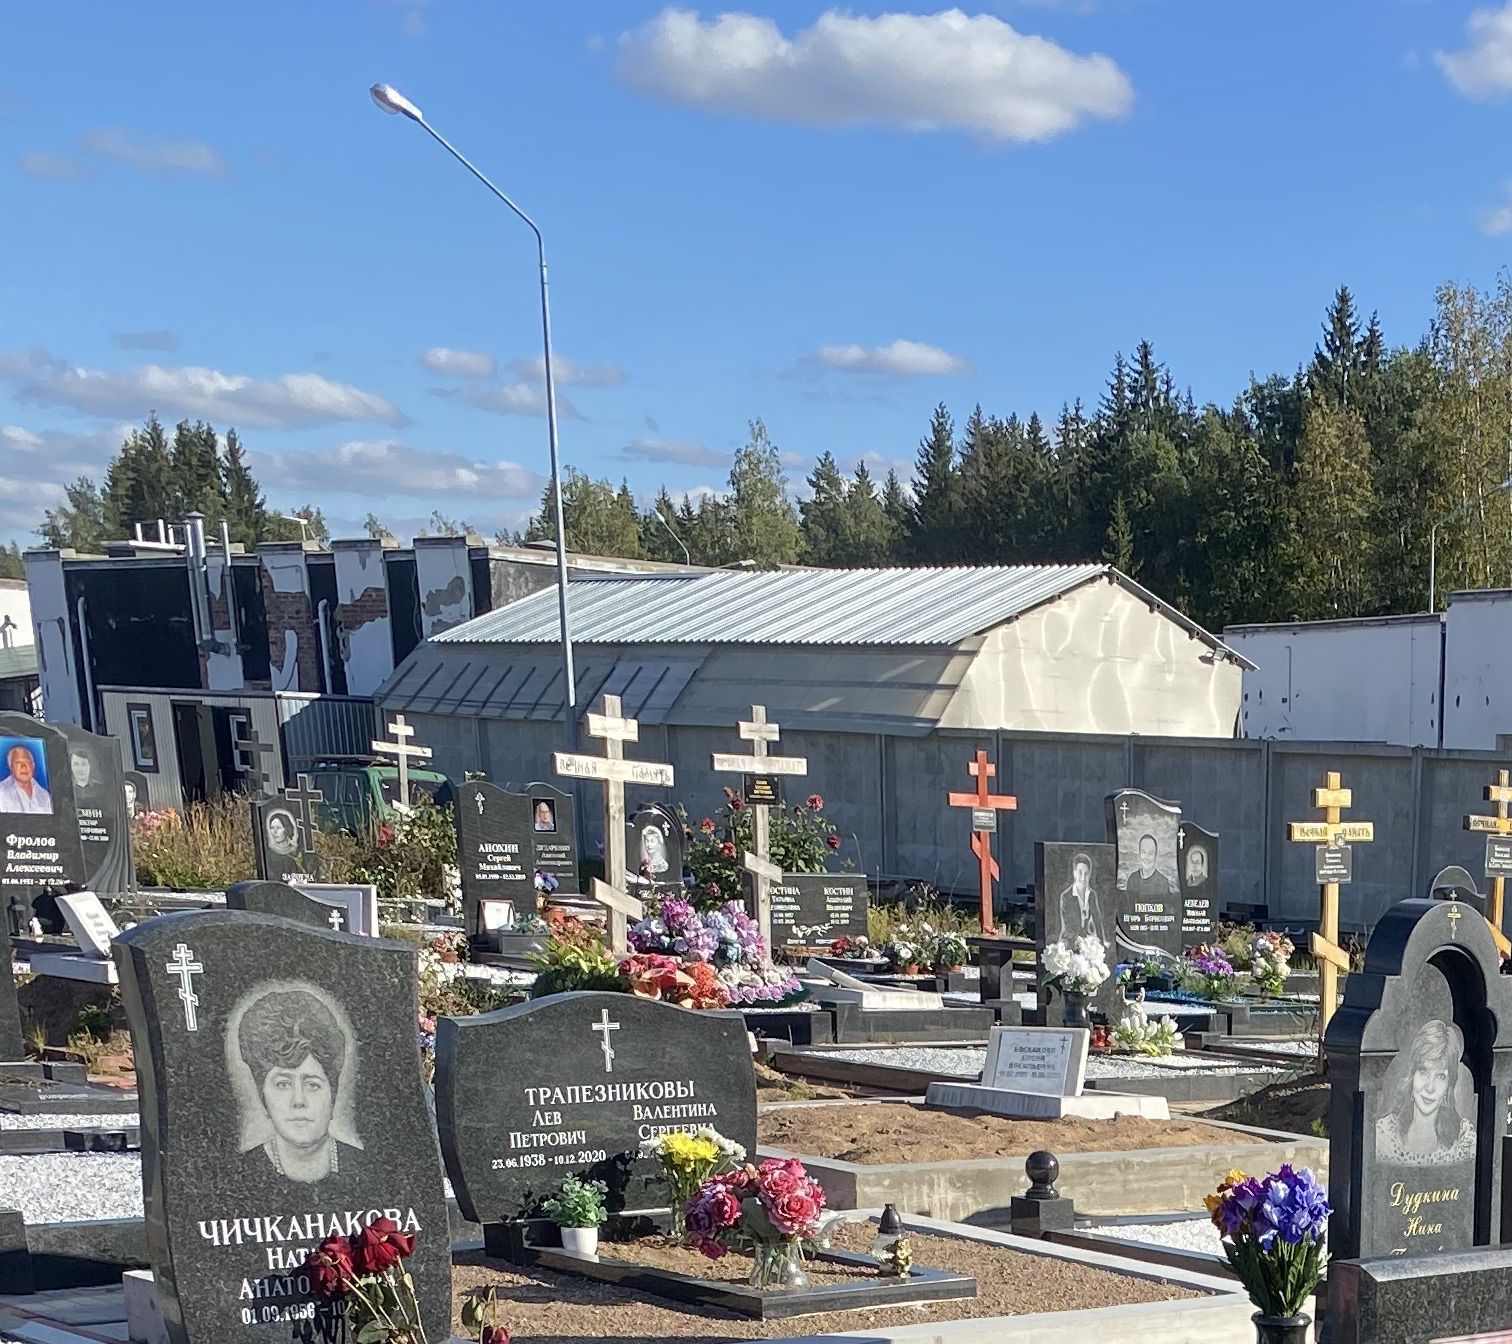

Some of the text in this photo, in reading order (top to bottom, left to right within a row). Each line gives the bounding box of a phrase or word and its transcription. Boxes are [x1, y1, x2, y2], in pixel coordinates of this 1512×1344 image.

[5, 832, 57, 849] Фролов
[478, 843, 520, 854] АНОХИН
[7, 849, 60, 863] Владимир
[5, 862, 64, 874] Алексеевич
[770, 886, 801, 896] ОСТИНА
[525, 1080, 695, 1106] ТРАПЕЗНИКОВЫ
[532, 1110, 563, 1127] ЛЕВ
[632, 1103, 718, 1121] ВАЛЕНТИНА
[509, 1130, 586, 1149] ПЕТРОВИЧ
[491, 1153, 547, 1170] 23.06.1938
[554, 1149, 607, 1165] 10.12.2020
[1390, 1182, 1460, 1215] Дудкина
[198, 1207, 423, 1247] ЧИЧКАНАКОВА
[1403, 1215, 1442, 1238] Нина
